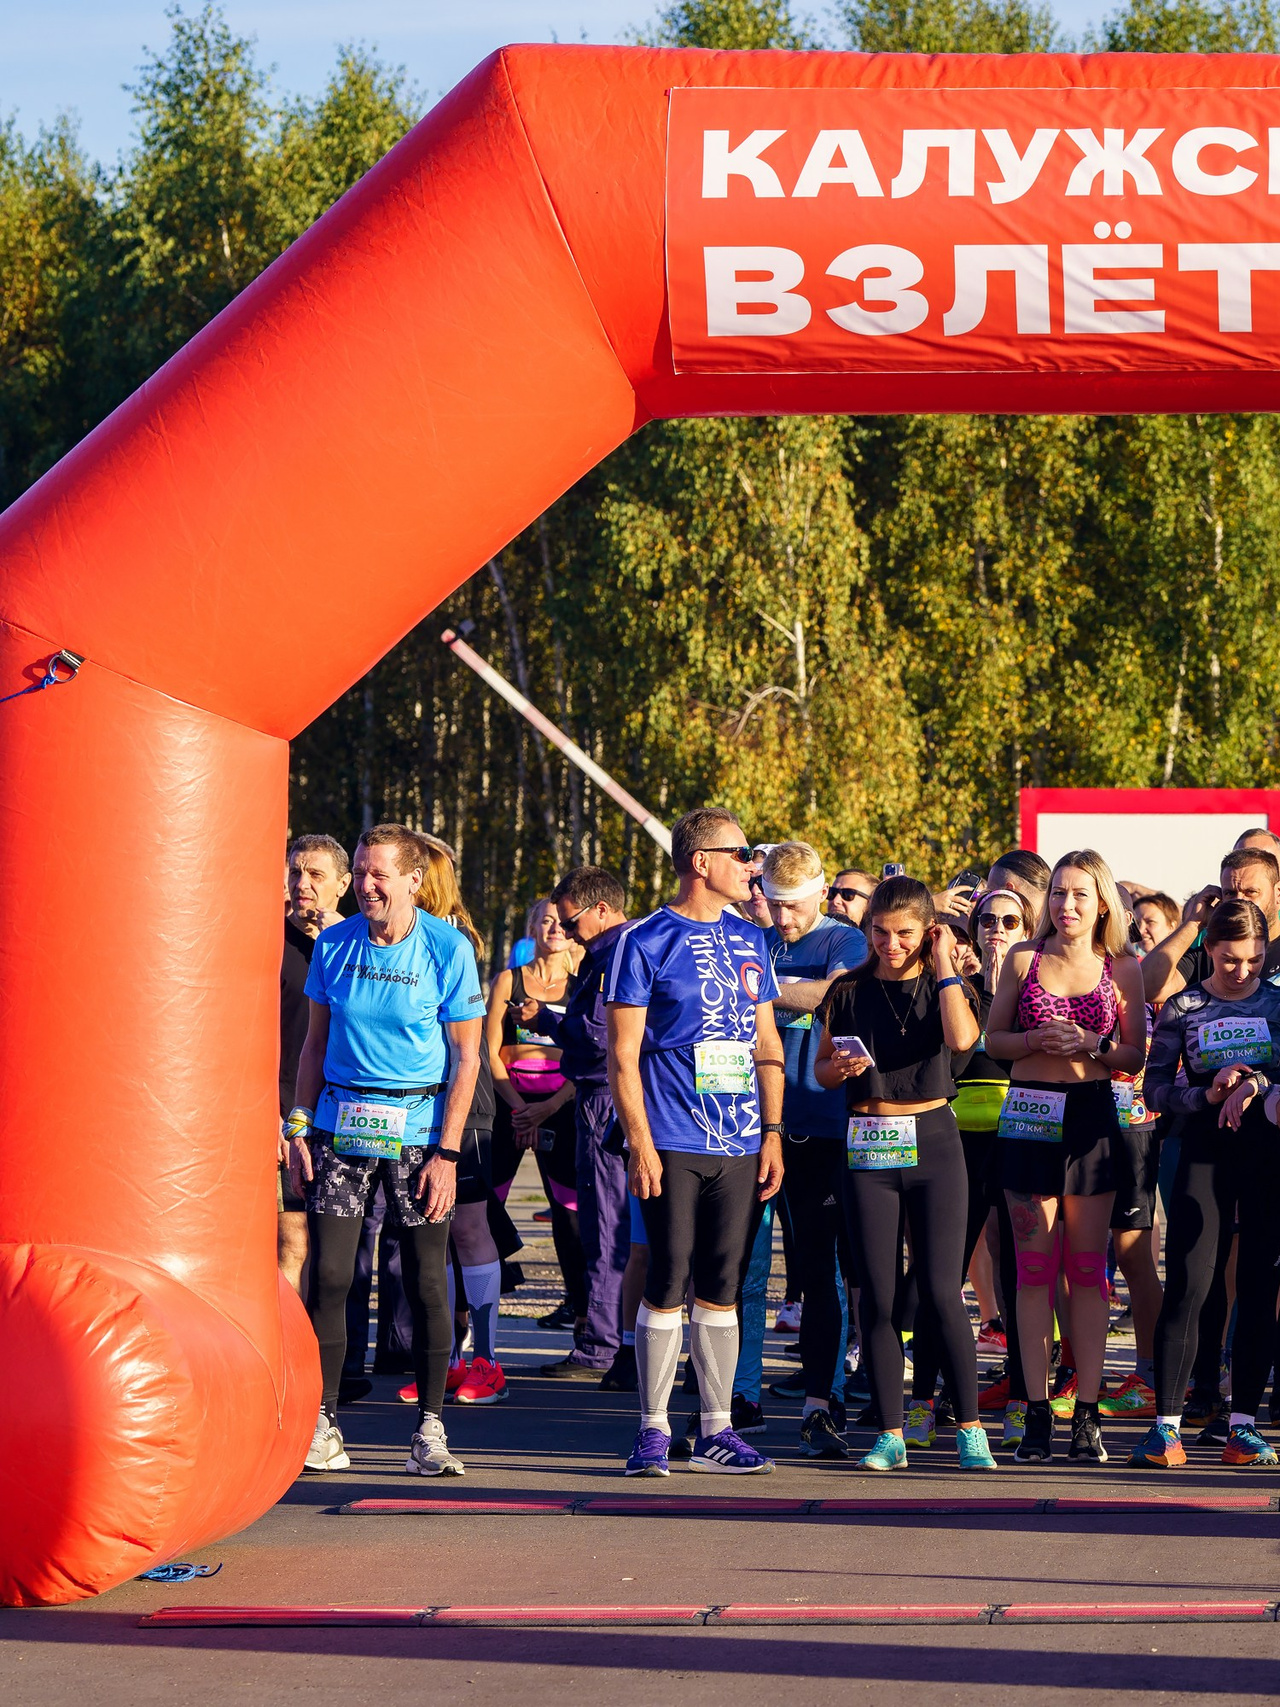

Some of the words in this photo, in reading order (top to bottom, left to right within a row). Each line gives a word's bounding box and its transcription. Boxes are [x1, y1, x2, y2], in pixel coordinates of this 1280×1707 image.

[1212, 1028, 1256, 1041] 1022
[708, 1054, 745, 1066] 1039
[1012, 1100, 1051, 1115] 1020
[349, 1115, 389, 1130] 1031
[861, 1129, 900, 1142] 1012
